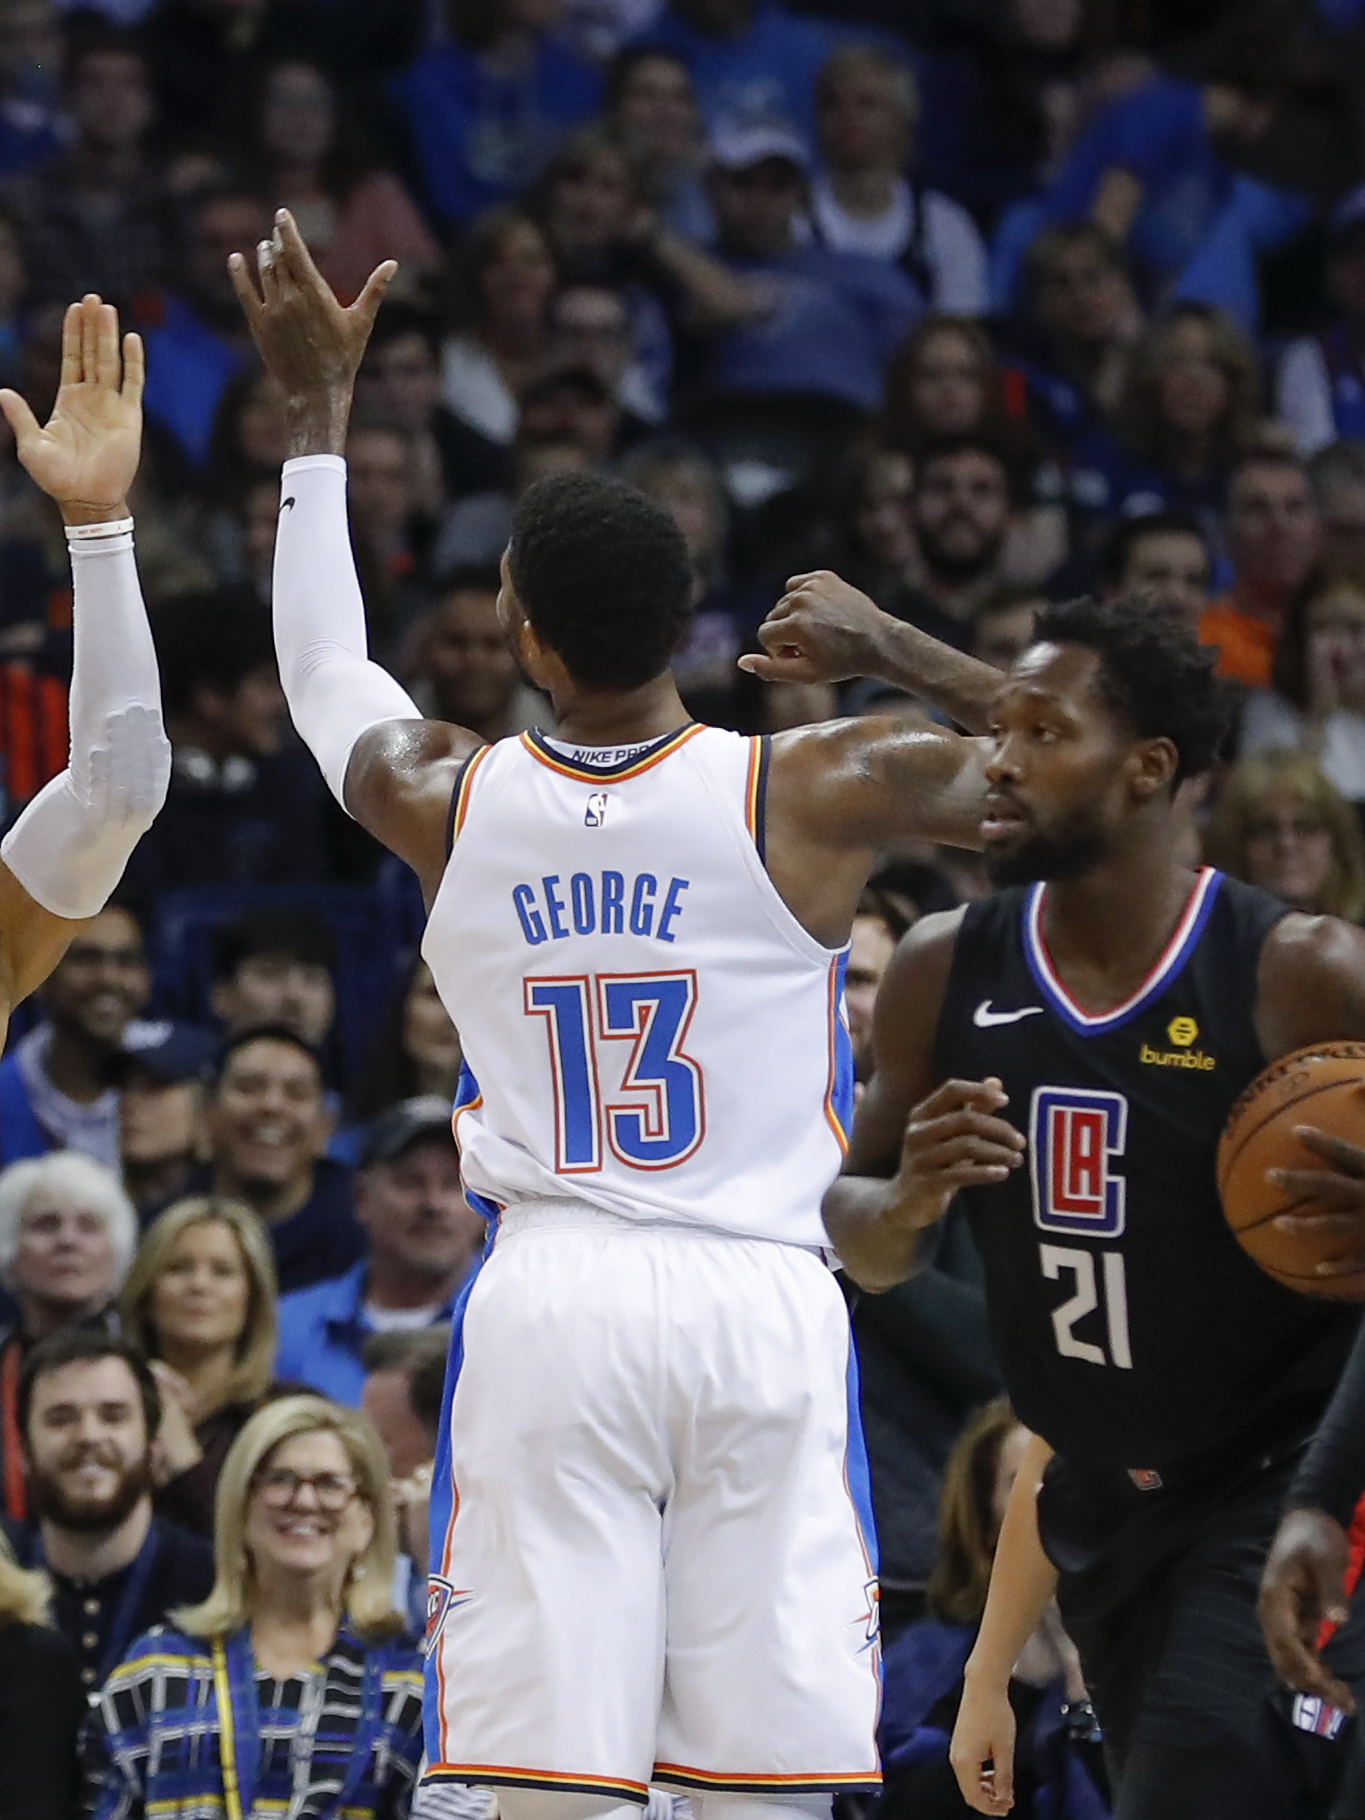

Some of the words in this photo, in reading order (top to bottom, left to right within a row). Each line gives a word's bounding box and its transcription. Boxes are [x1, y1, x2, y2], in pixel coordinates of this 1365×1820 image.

[571, 749, 611, 763] NIKE
[512, 870, 690, 945] GEORGE
[523, 969, 706, 1174] 13
[1140, 1044, 1215, 1071] bumble
[1038, 1242, 1133, 1369] 21
